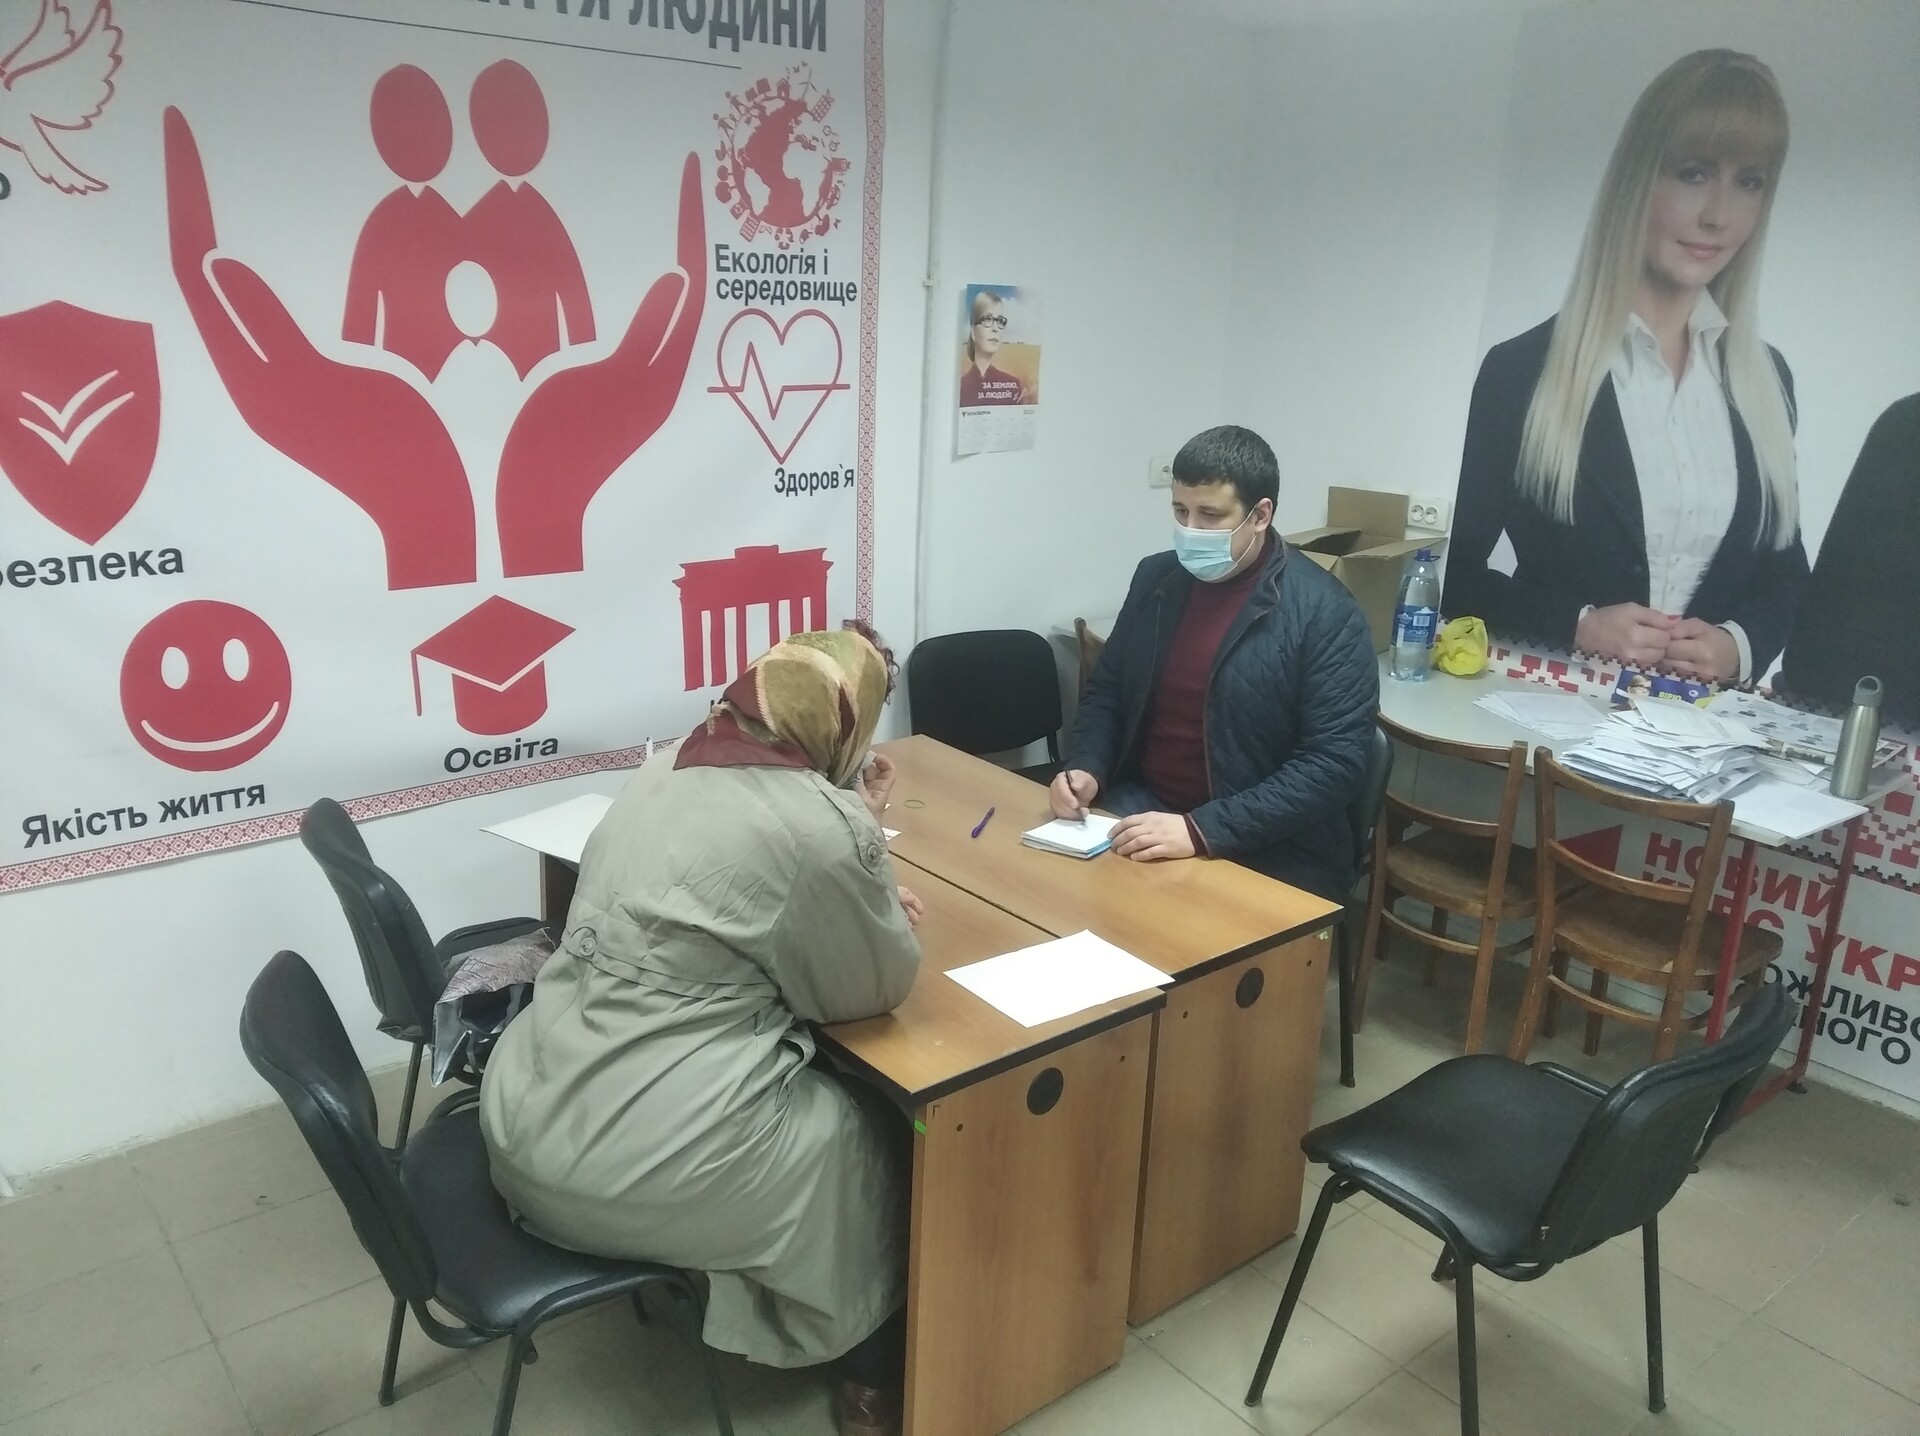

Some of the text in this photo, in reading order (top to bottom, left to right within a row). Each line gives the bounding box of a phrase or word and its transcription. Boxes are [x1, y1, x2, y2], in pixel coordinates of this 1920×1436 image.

[714, 244, 829, 276] Екологія і
[716, 276, 858, 306] середовище
[0, 548, 184, 588] езпека
[443, 737, 560, 774] Освіта
[22, 784, 267, 849] Якість життя
